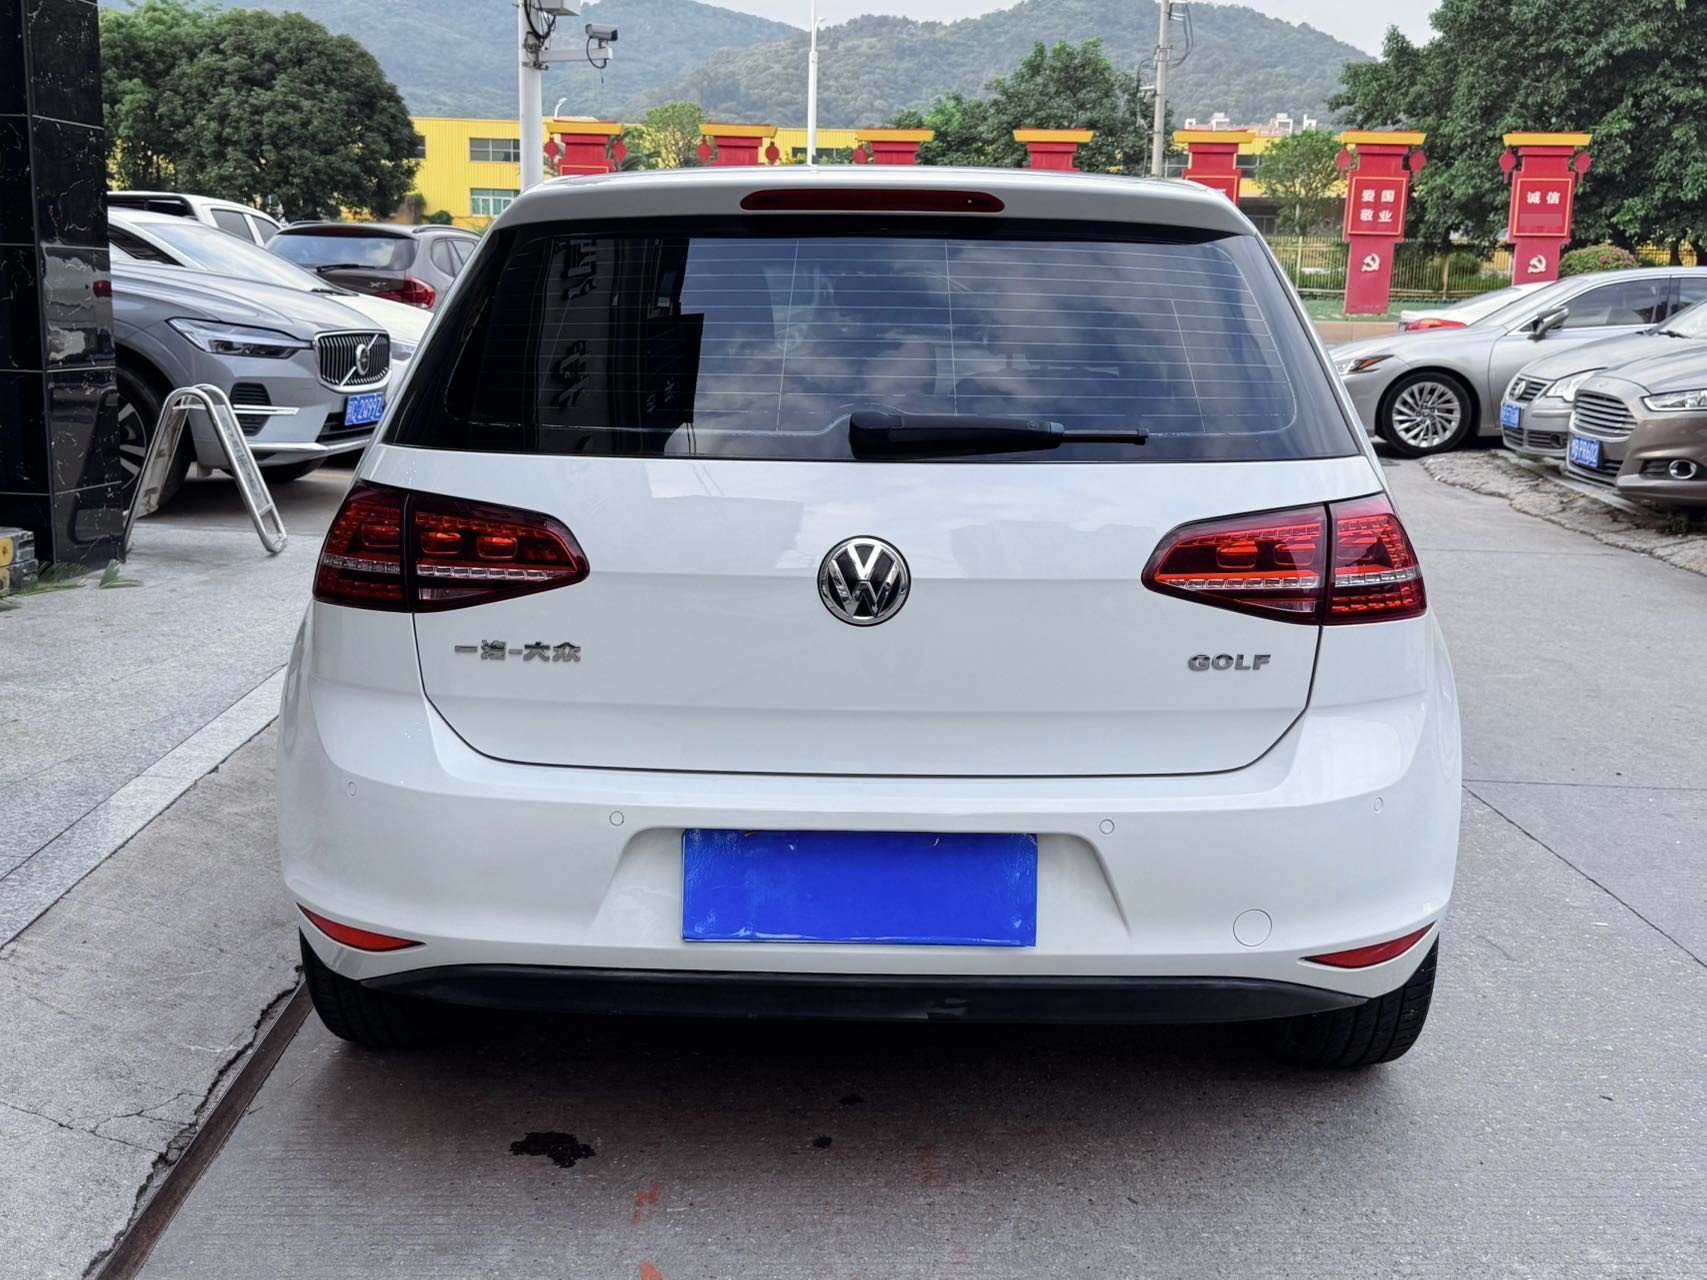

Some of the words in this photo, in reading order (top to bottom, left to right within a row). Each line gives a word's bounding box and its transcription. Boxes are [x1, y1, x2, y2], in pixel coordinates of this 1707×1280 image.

[1361, 189, 1395, 203] 爱国
[1527, 191, 1561, 204] 诚信
[1360, 208, 1392, 223] 敬业
[1187, 653, 1271, 672] GOLF
